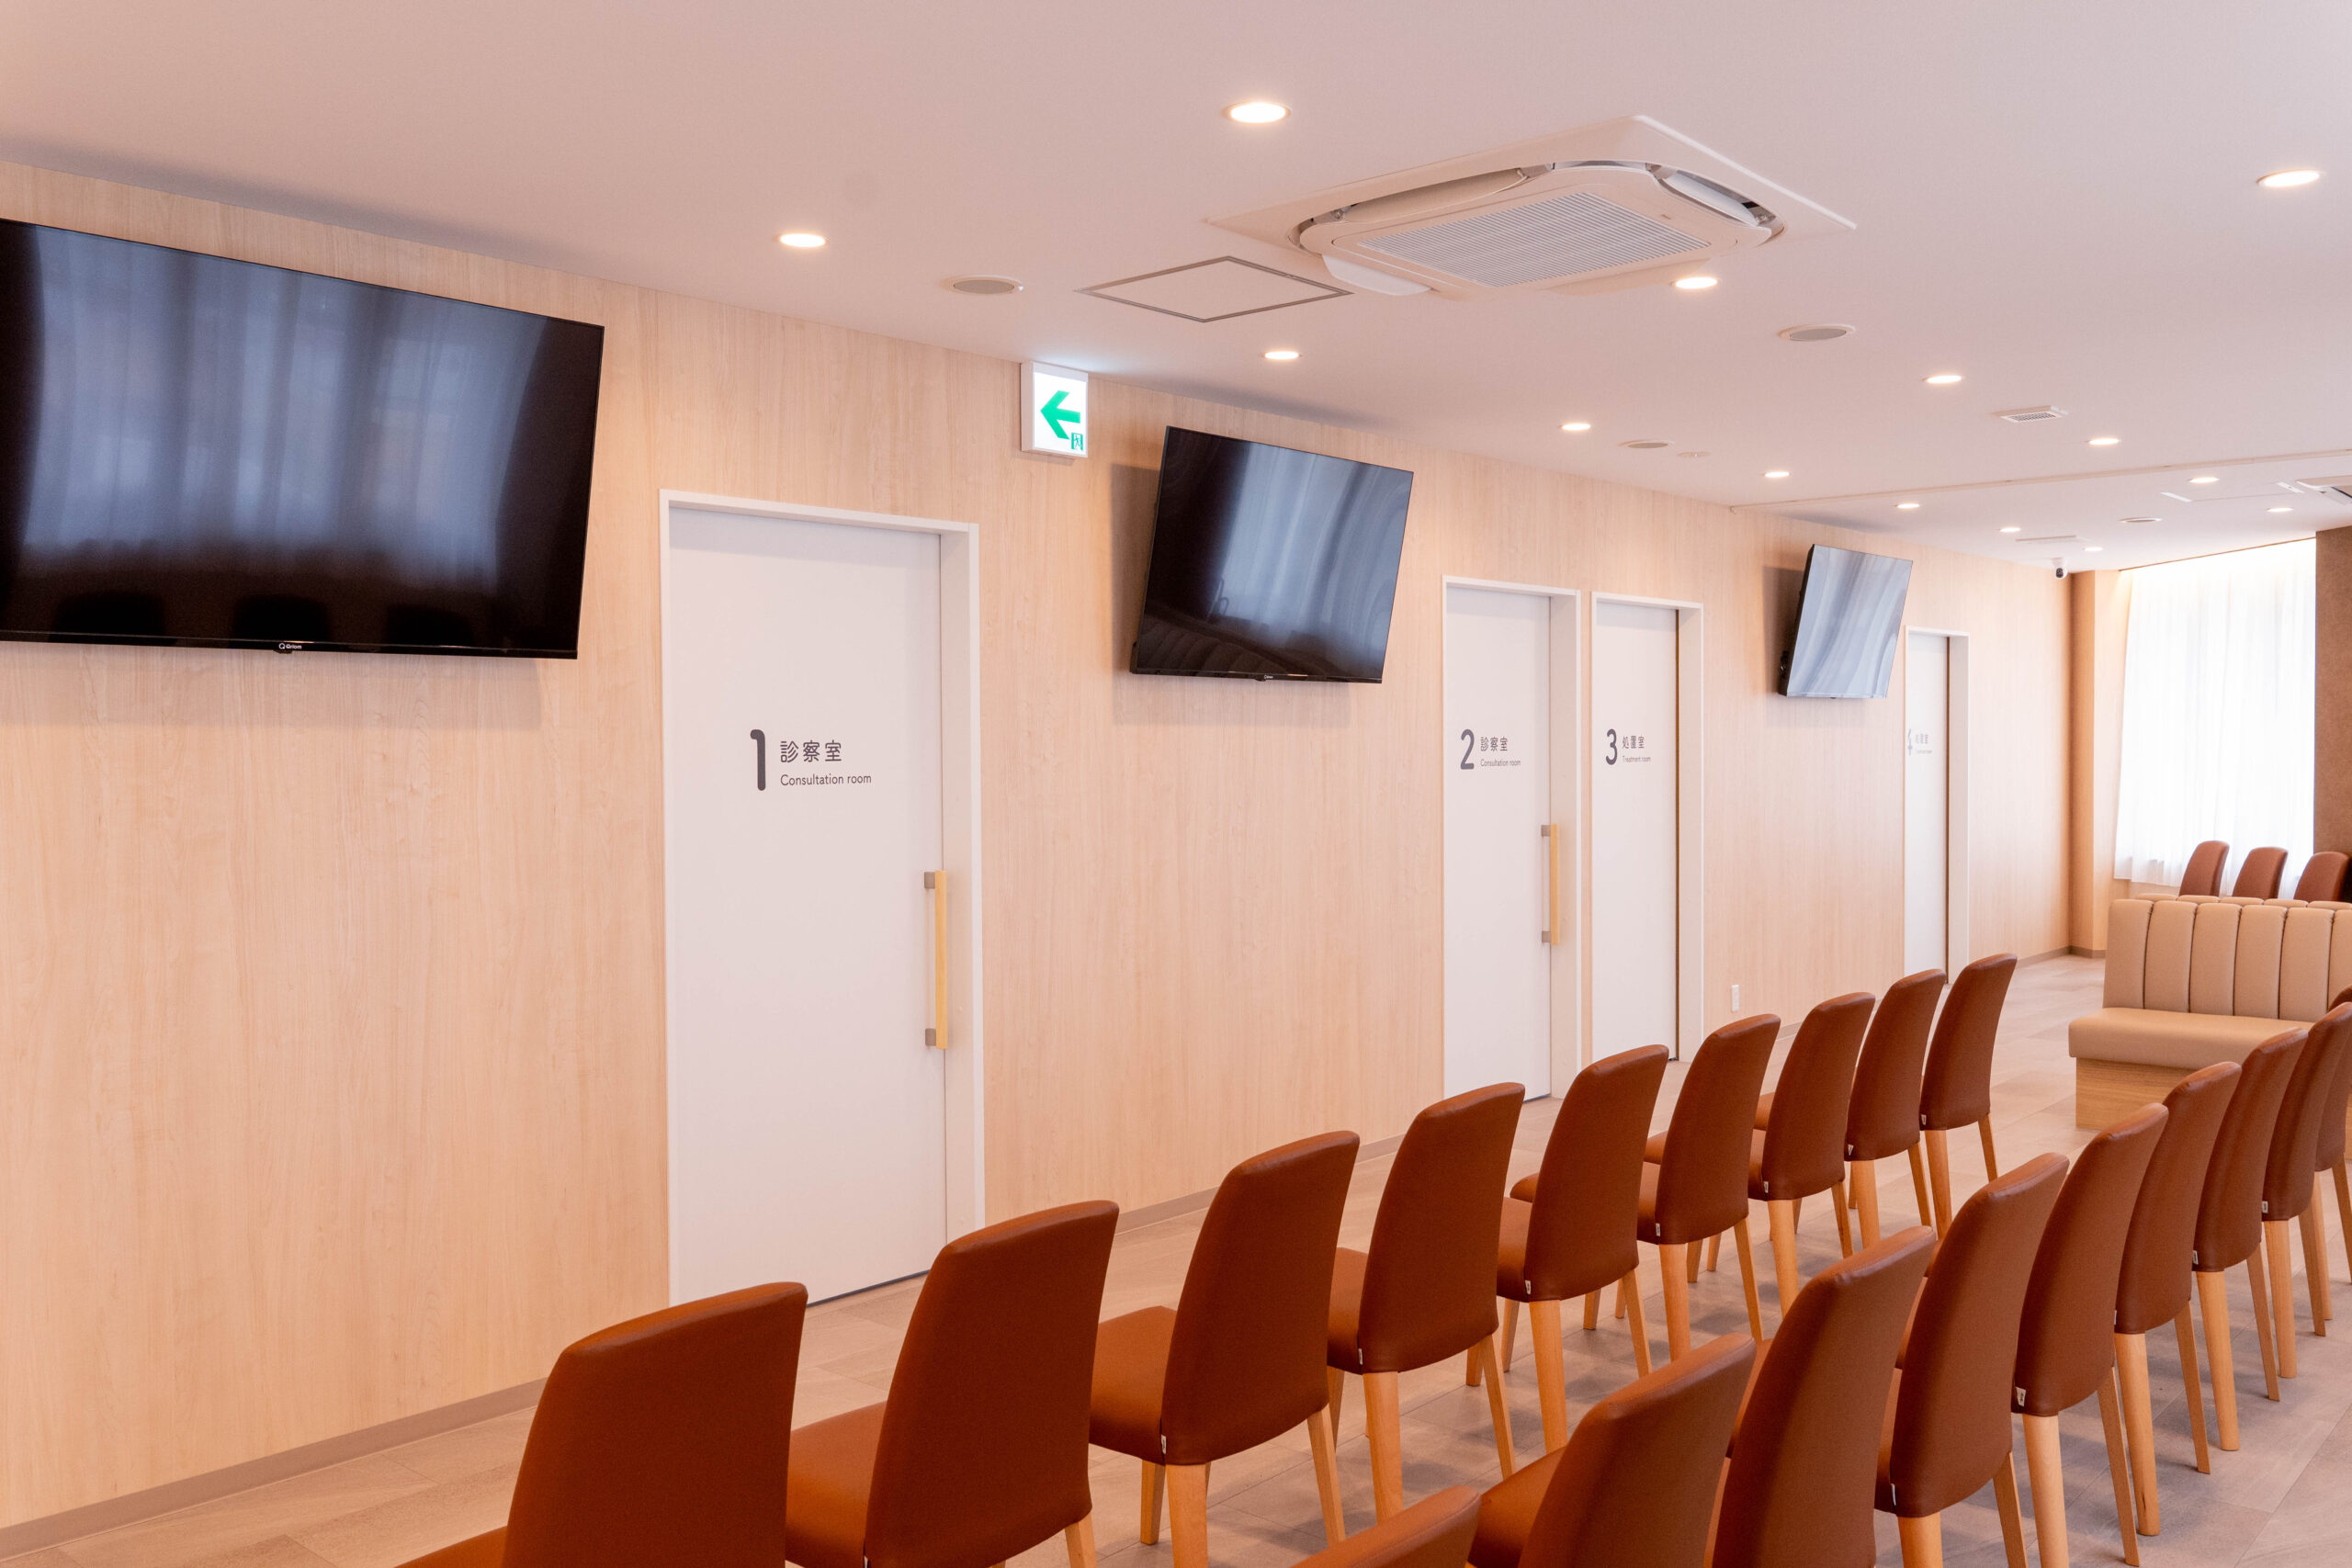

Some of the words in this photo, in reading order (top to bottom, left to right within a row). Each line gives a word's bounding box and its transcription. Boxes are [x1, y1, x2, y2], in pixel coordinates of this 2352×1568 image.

[780, 739, 842, 763] 診察室
[1460, 728, 1475, 770] 2
[1480, 736, 1509, 751] 診察室
[1605, 728, 1618, 765] 3
[750, 728, 766, 791] 1
[1480, 759, 1509, 767] Consultation
[780, 773, 843, 786] Consultation
[847, 774, 872, 784] room
